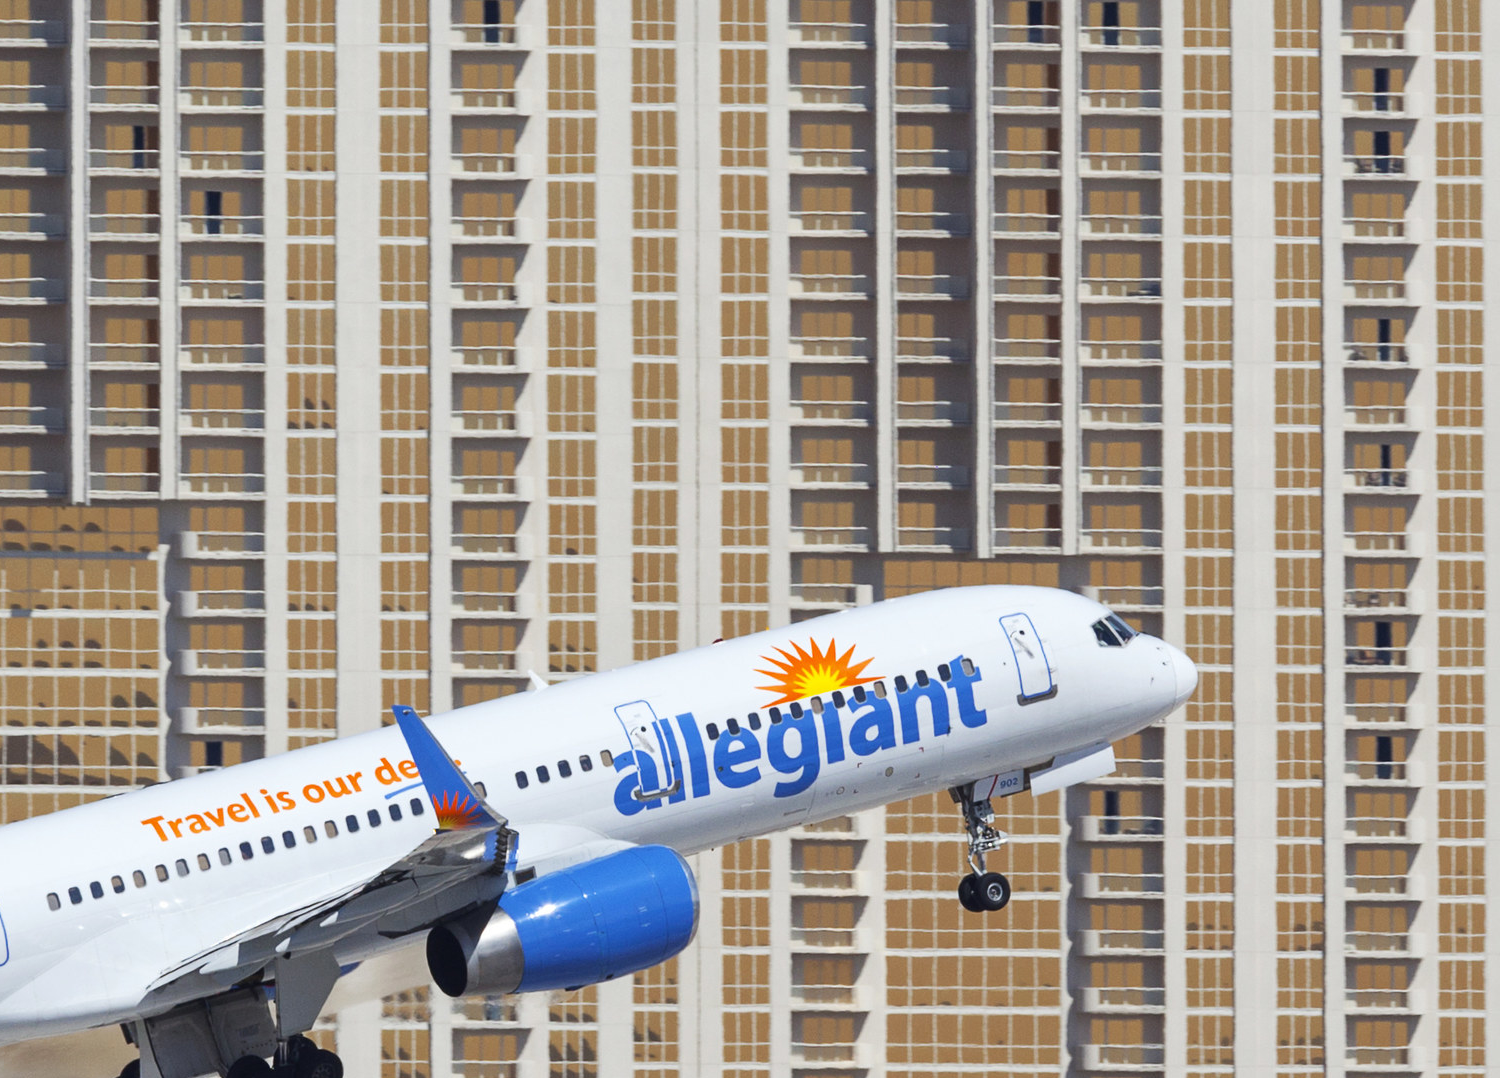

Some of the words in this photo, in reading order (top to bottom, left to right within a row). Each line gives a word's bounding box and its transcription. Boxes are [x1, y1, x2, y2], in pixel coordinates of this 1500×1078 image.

[613, 654, 988, 816] allegiant
[141, 792, 261, 842] Travel
[259, 788, 296, 814] is
[302, 771, 363, 803] our
[1000, 777, 1018, 789] 902
